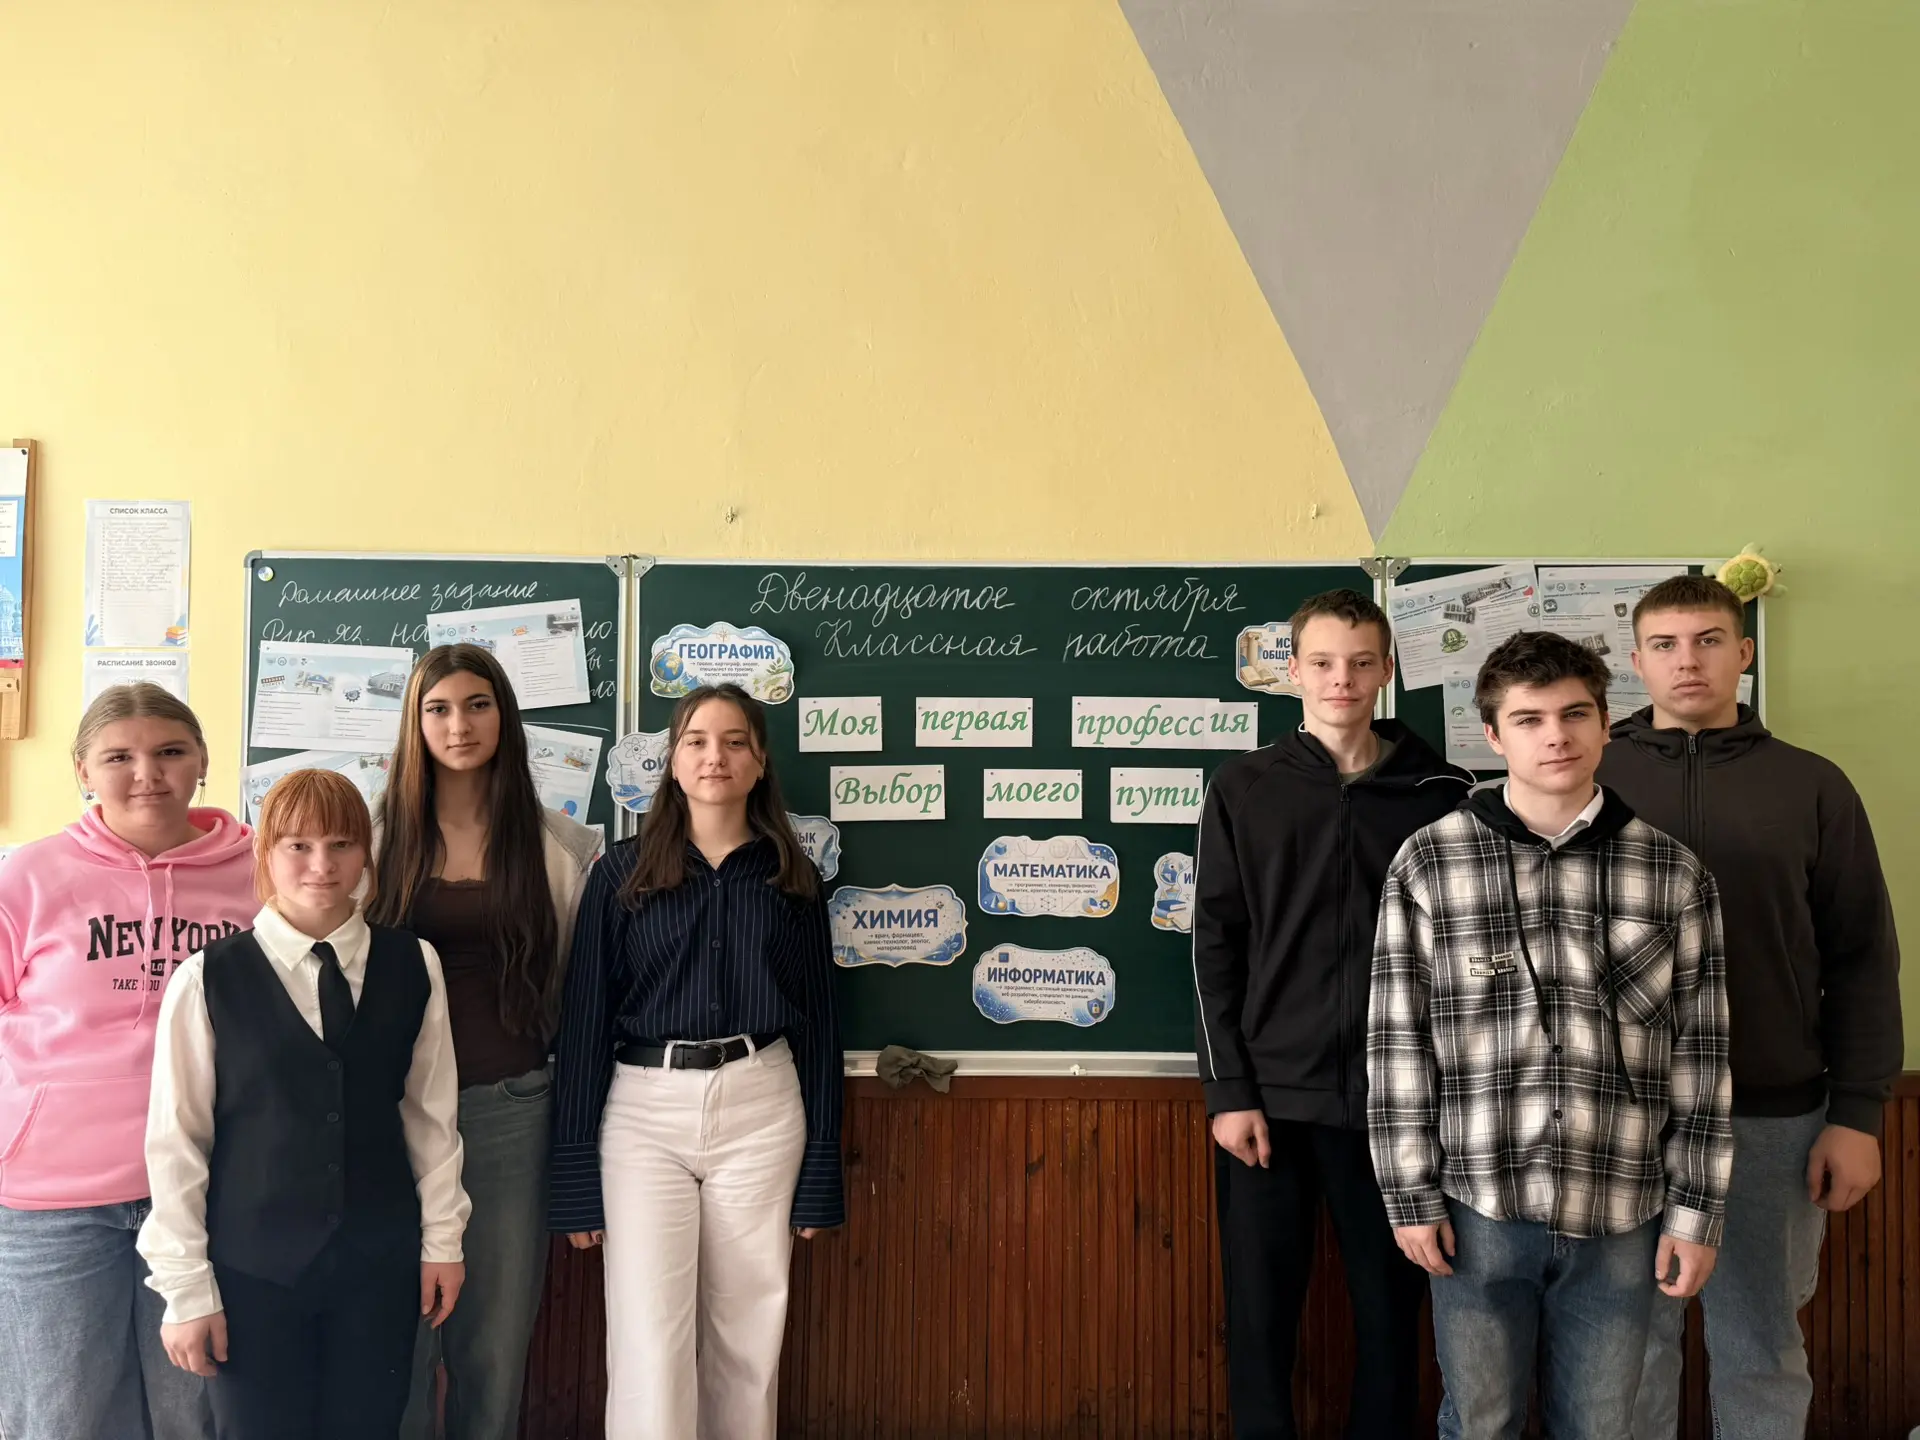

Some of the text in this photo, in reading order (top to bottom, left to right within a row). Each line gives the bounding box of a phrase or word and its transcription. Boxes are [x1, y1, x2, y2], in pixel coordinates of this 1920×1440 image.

[278, 580, 421, 607] Домашнее
[750, 572, 1246, 632] Двенадцатое октября
[679, 644, 775, 659] ГЕОГРАФИЯ
[816, 618, 1218, 663] Классная работа
[803, 704, 1248, 746] Моя первая профессия
[834, 772, 1200, 816] Выбор моего пути
[994, 863, 1110, 879] МАТЕМАТИКА
[852, 909, 938, 929] ХИМИЯ
[86, 914, 163, 961] NEW
[112, 978, 138, 990] TAKE
[988, 967, 1106, 985] ИНФОРМАТИКА
